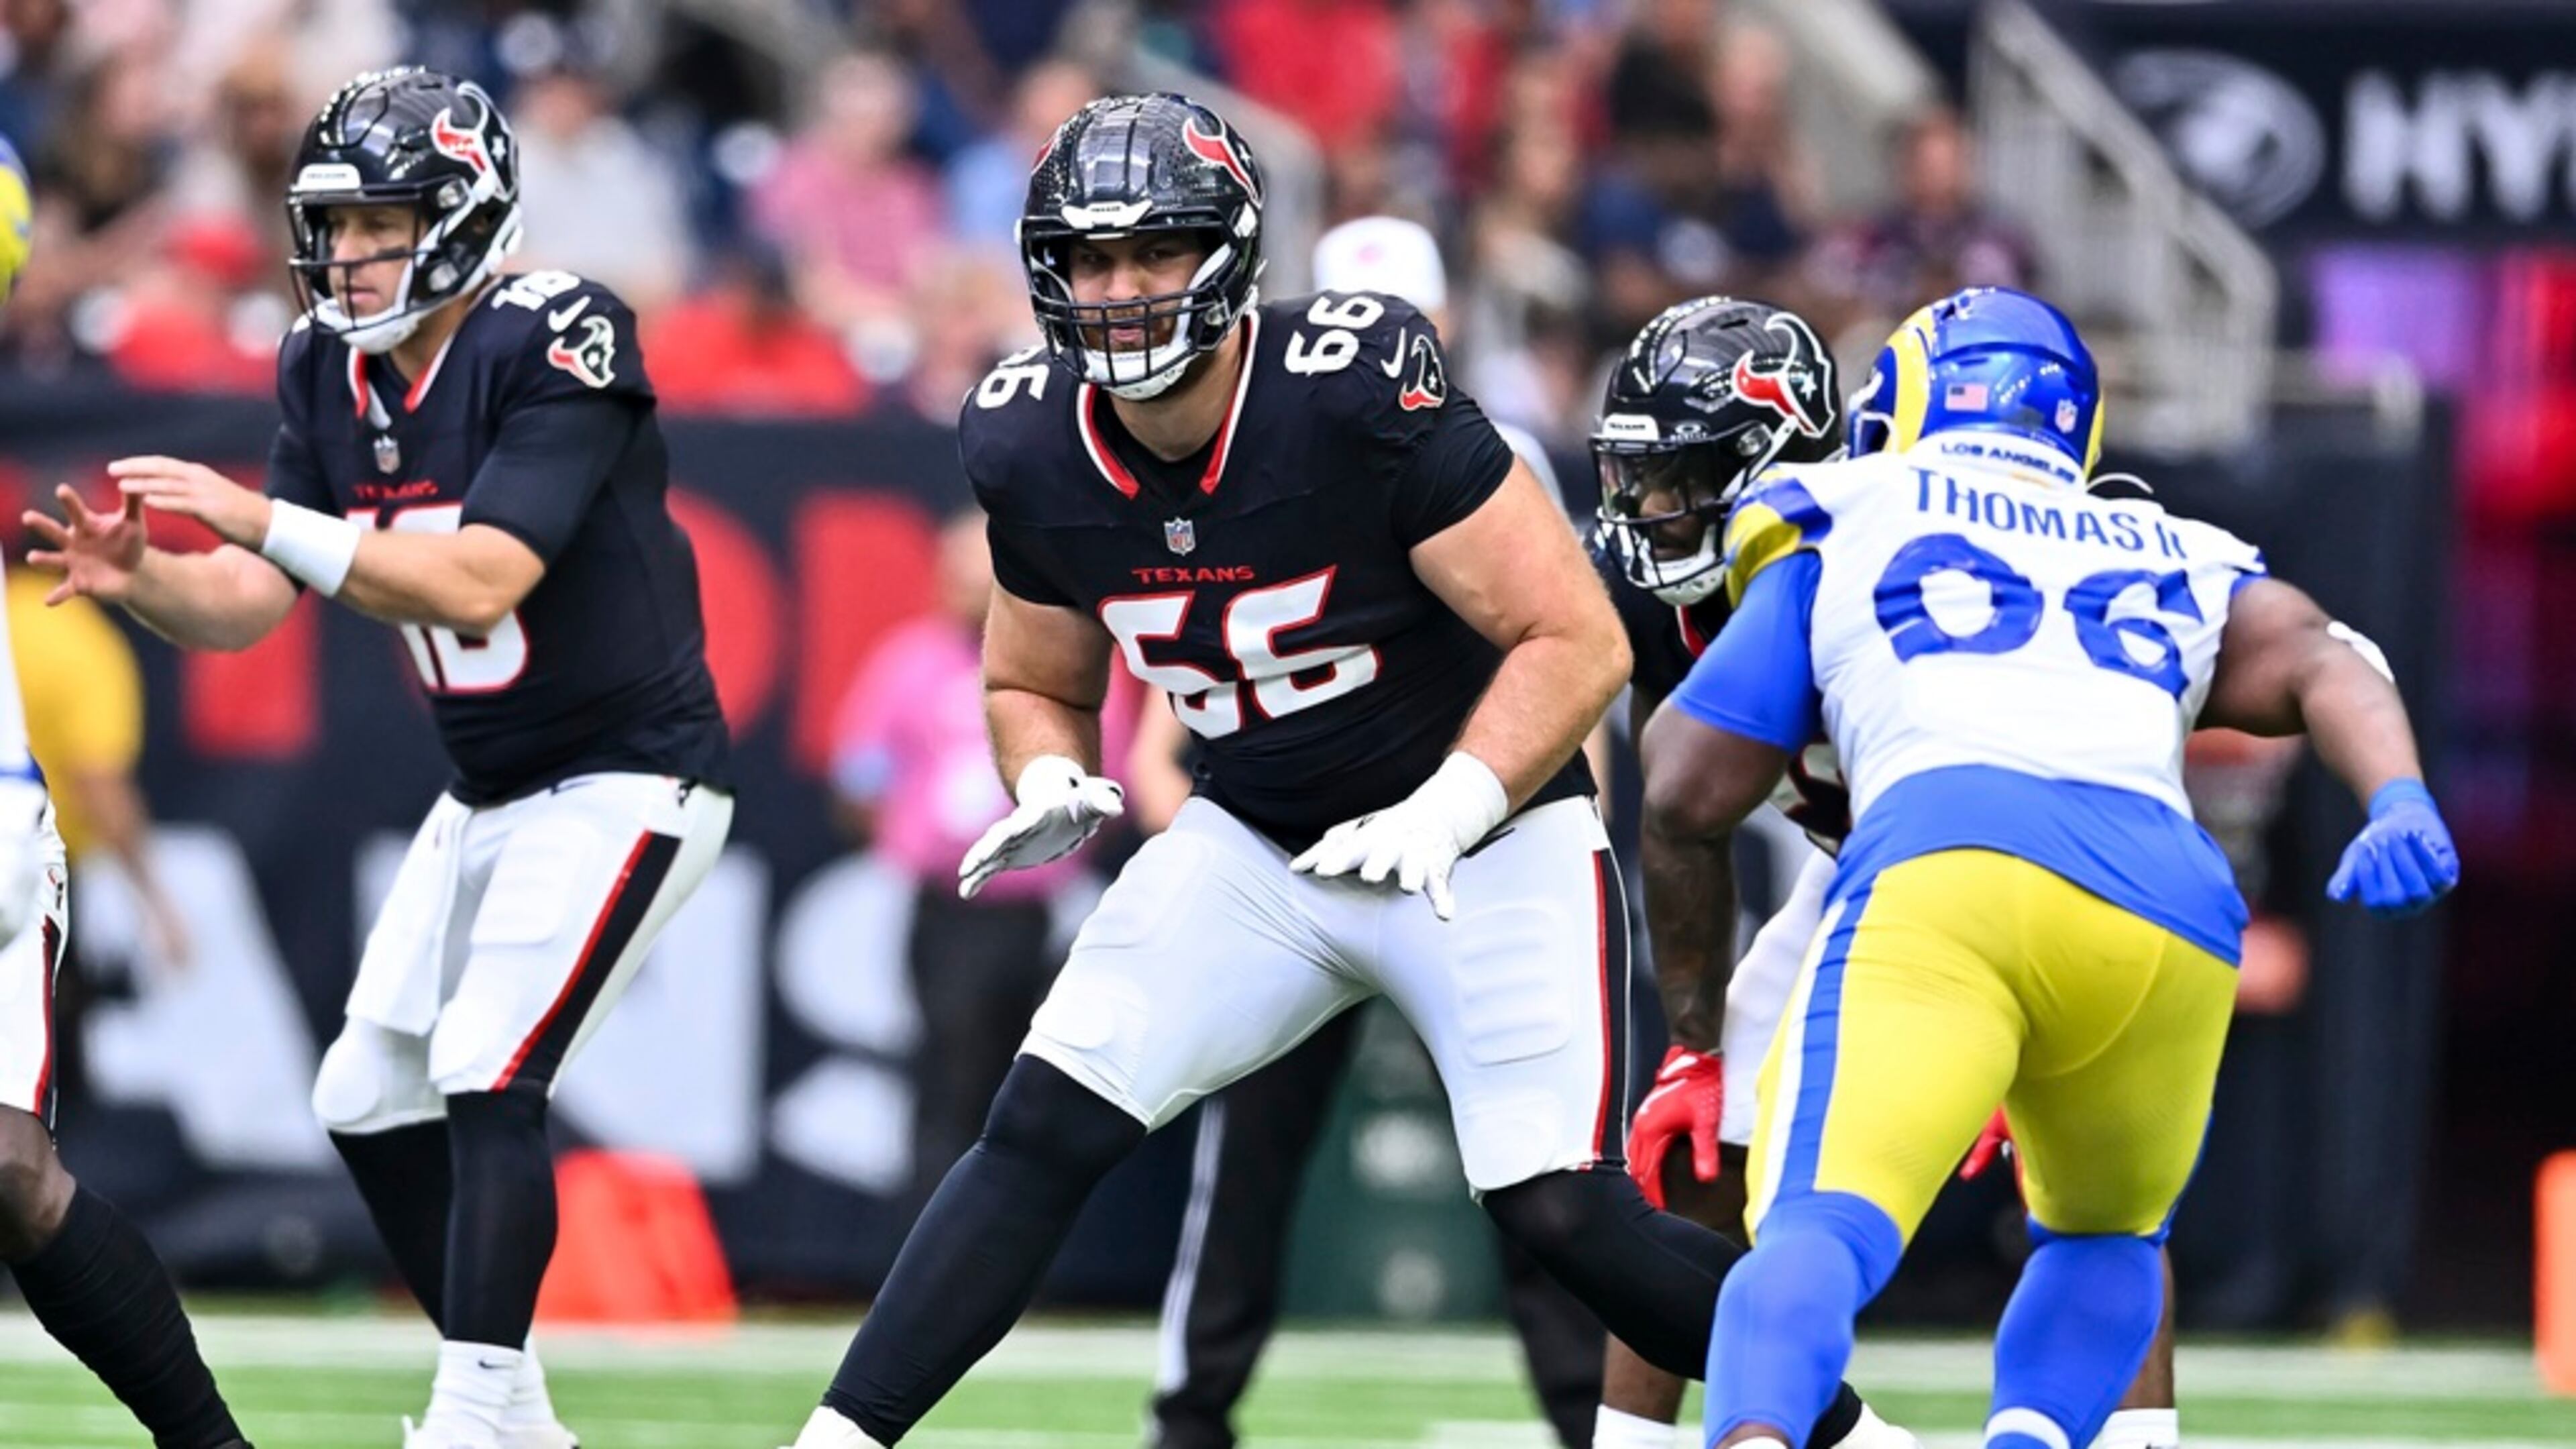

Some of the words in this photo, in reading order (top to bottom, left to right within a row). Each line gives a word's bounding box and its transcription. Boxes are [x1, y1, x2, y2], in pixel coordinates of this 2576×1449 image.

[2345, 70, 2576, 219] HY
[1284, 296, 1385, 376] 66
[1941, 443, 1983, 455] LOS
[1988, 447, 2076, 484] ANGELES
[1909, 466, 2145, 551] THOMAS
[2155, 521, 2187, 559] II
[1132, 566, 1255, 584] TEXANS
